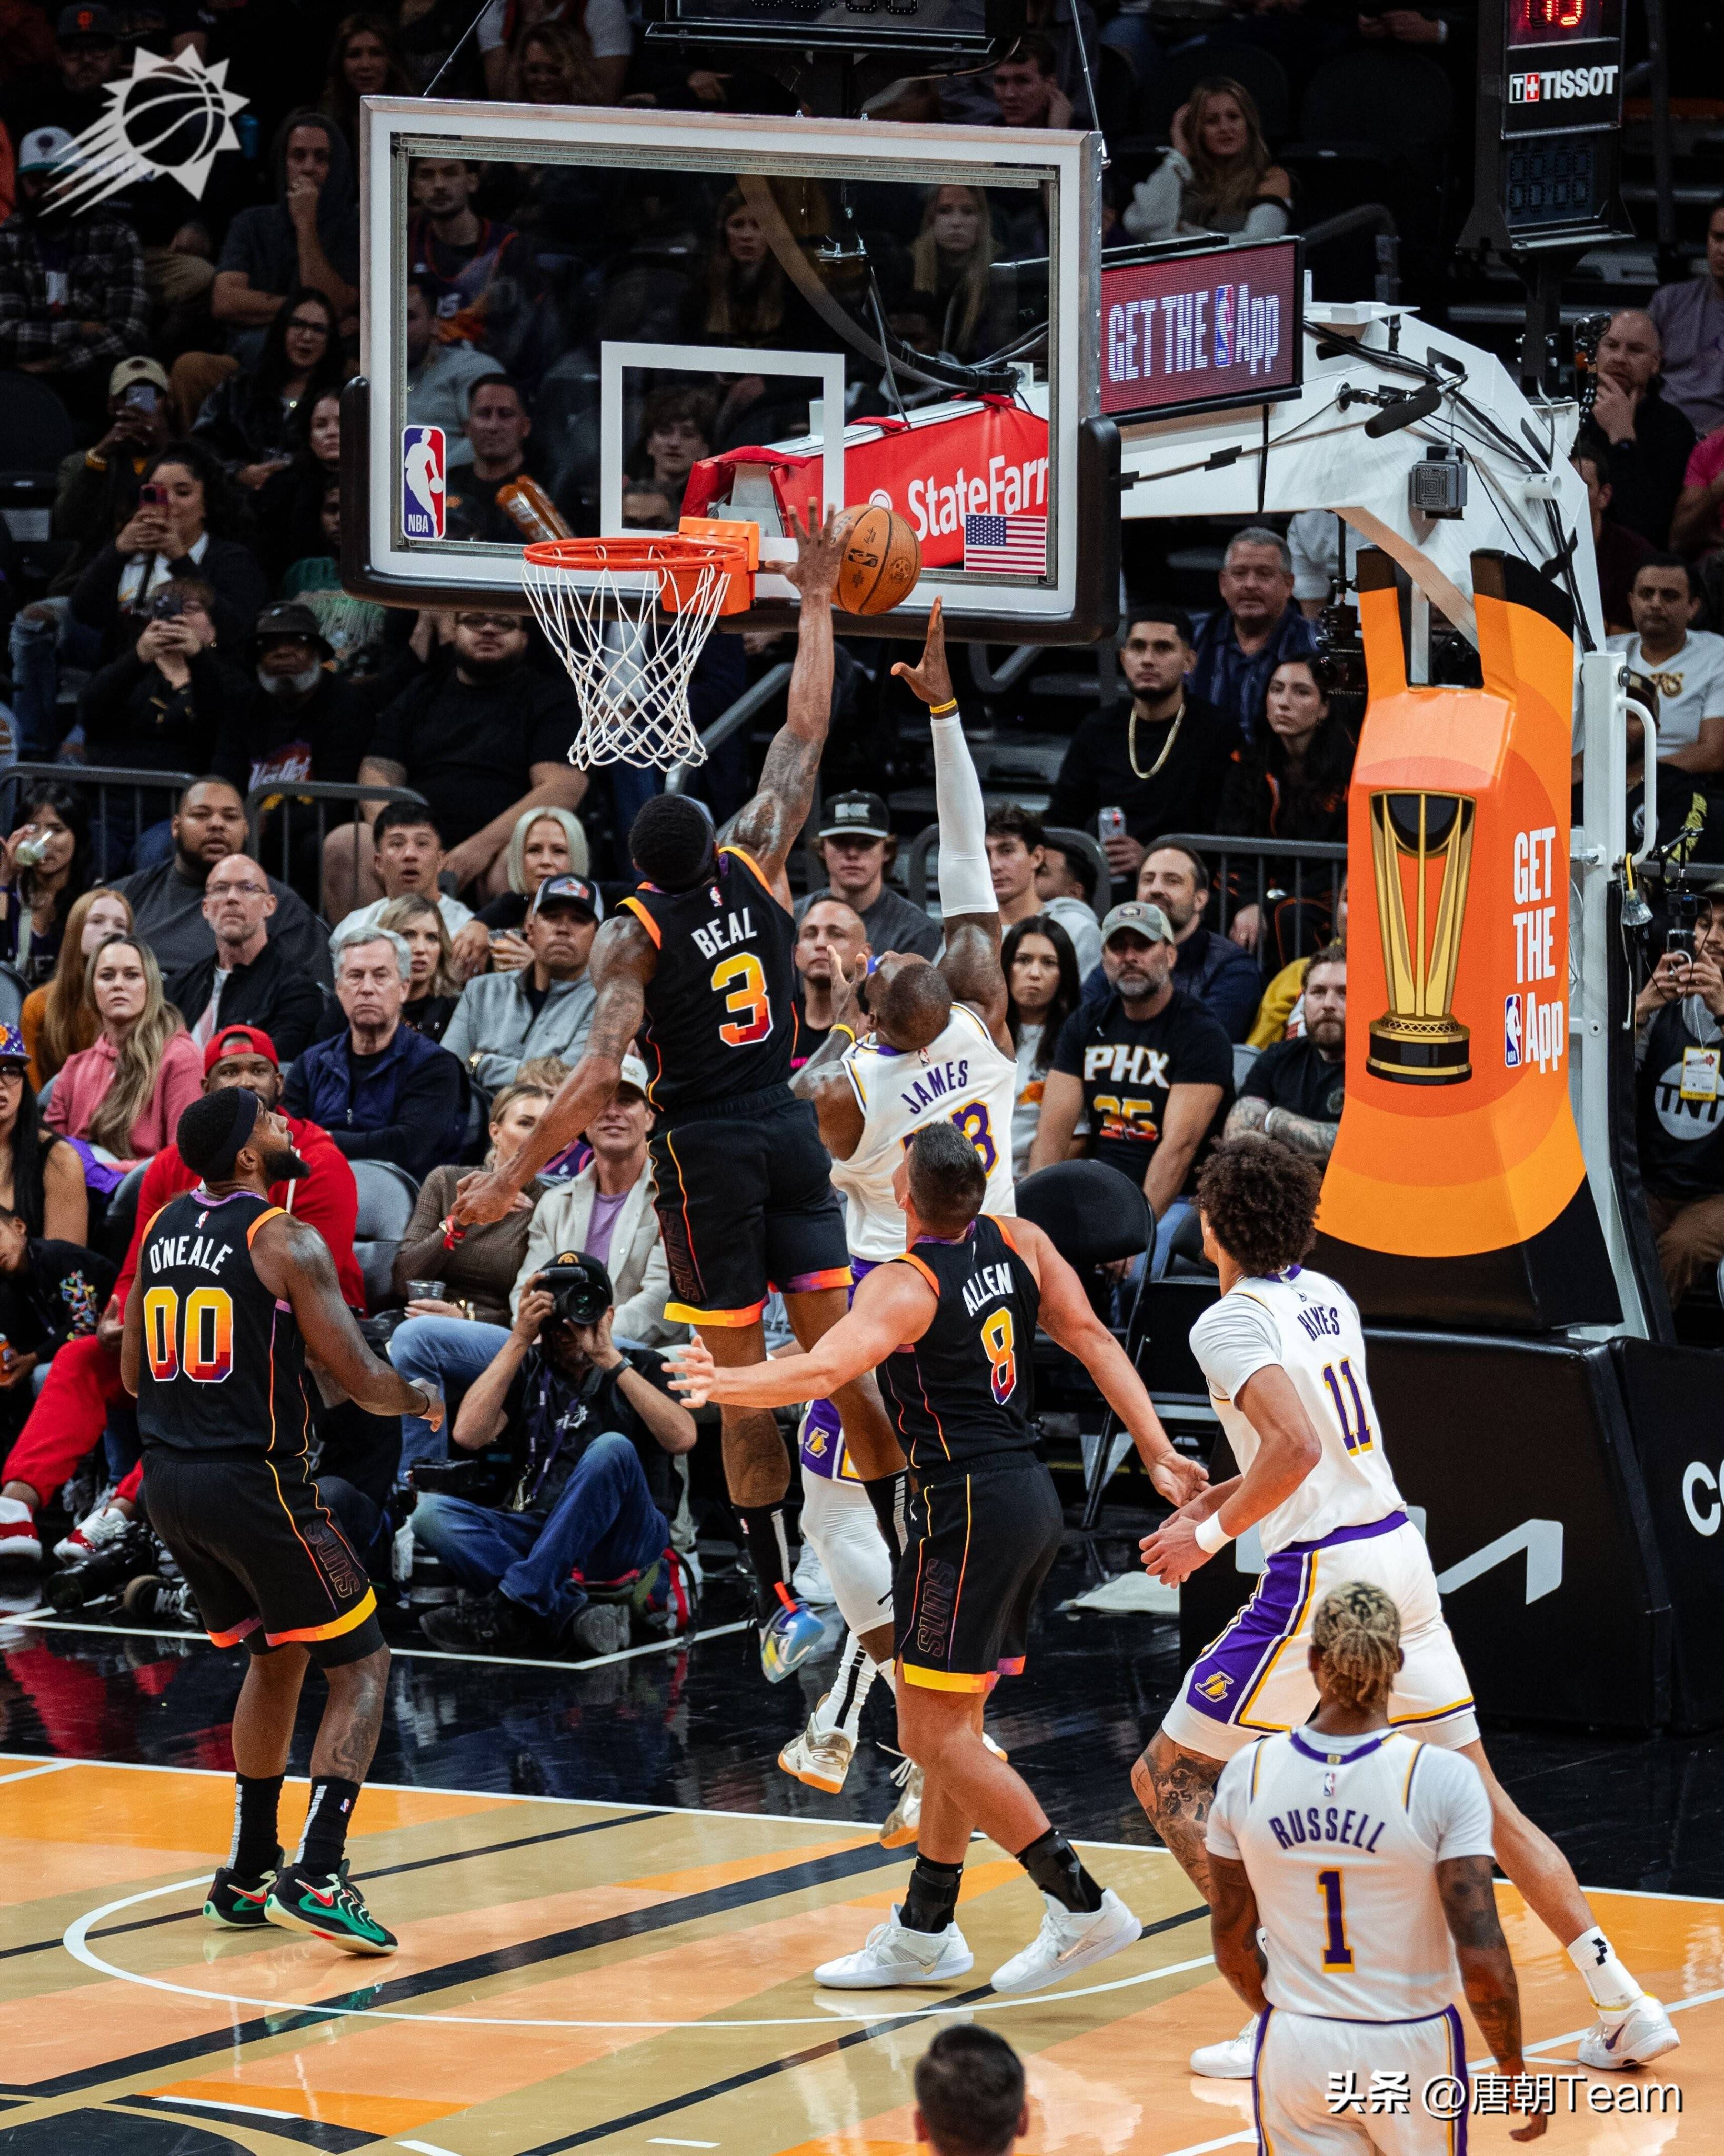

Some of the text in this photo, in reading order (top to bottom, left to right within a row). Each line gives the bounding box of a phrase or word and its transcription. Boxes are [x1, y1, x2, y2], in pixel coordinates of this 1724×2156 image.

[1540, 65, 1619, 99] TISSOT
[1108, 284, 1279, 381] GET THE App
[408, 514, 429, 532] NBA
[1513, 826, 1556, 905] GET
[690, 907, 757, 959] BEAL
[1513, 906, 1556, 984] THE
[711, 952, 774, 1047] 3
[1525, 992, 1563, 1074] App
[901, 1060, 968, 1114] JAMES
[1084, 1044, 1170, 1089] PHX
[1094, 1094, 1159, 1141] 35
[149, 1236, 233, 1275] O'NEALE
[962, 1263, 1014, 1317] ALLEN
[143, 1286, 233, 1382] 00
[980, 1306, 1016, 1405] 8
[1297, 1306, 1340, 1341] HAYES
[1321, 1356, 1374, 1456] 11
[1683, 1461, 1724, 1536] C
[304, 1519, 360, 1598] SUNS
[917, 1558, 956, 1658] SUNS
[1268, 1807, 1385, 1854] RUSSELL
[1315, 1866, 1356, 1973] 1
